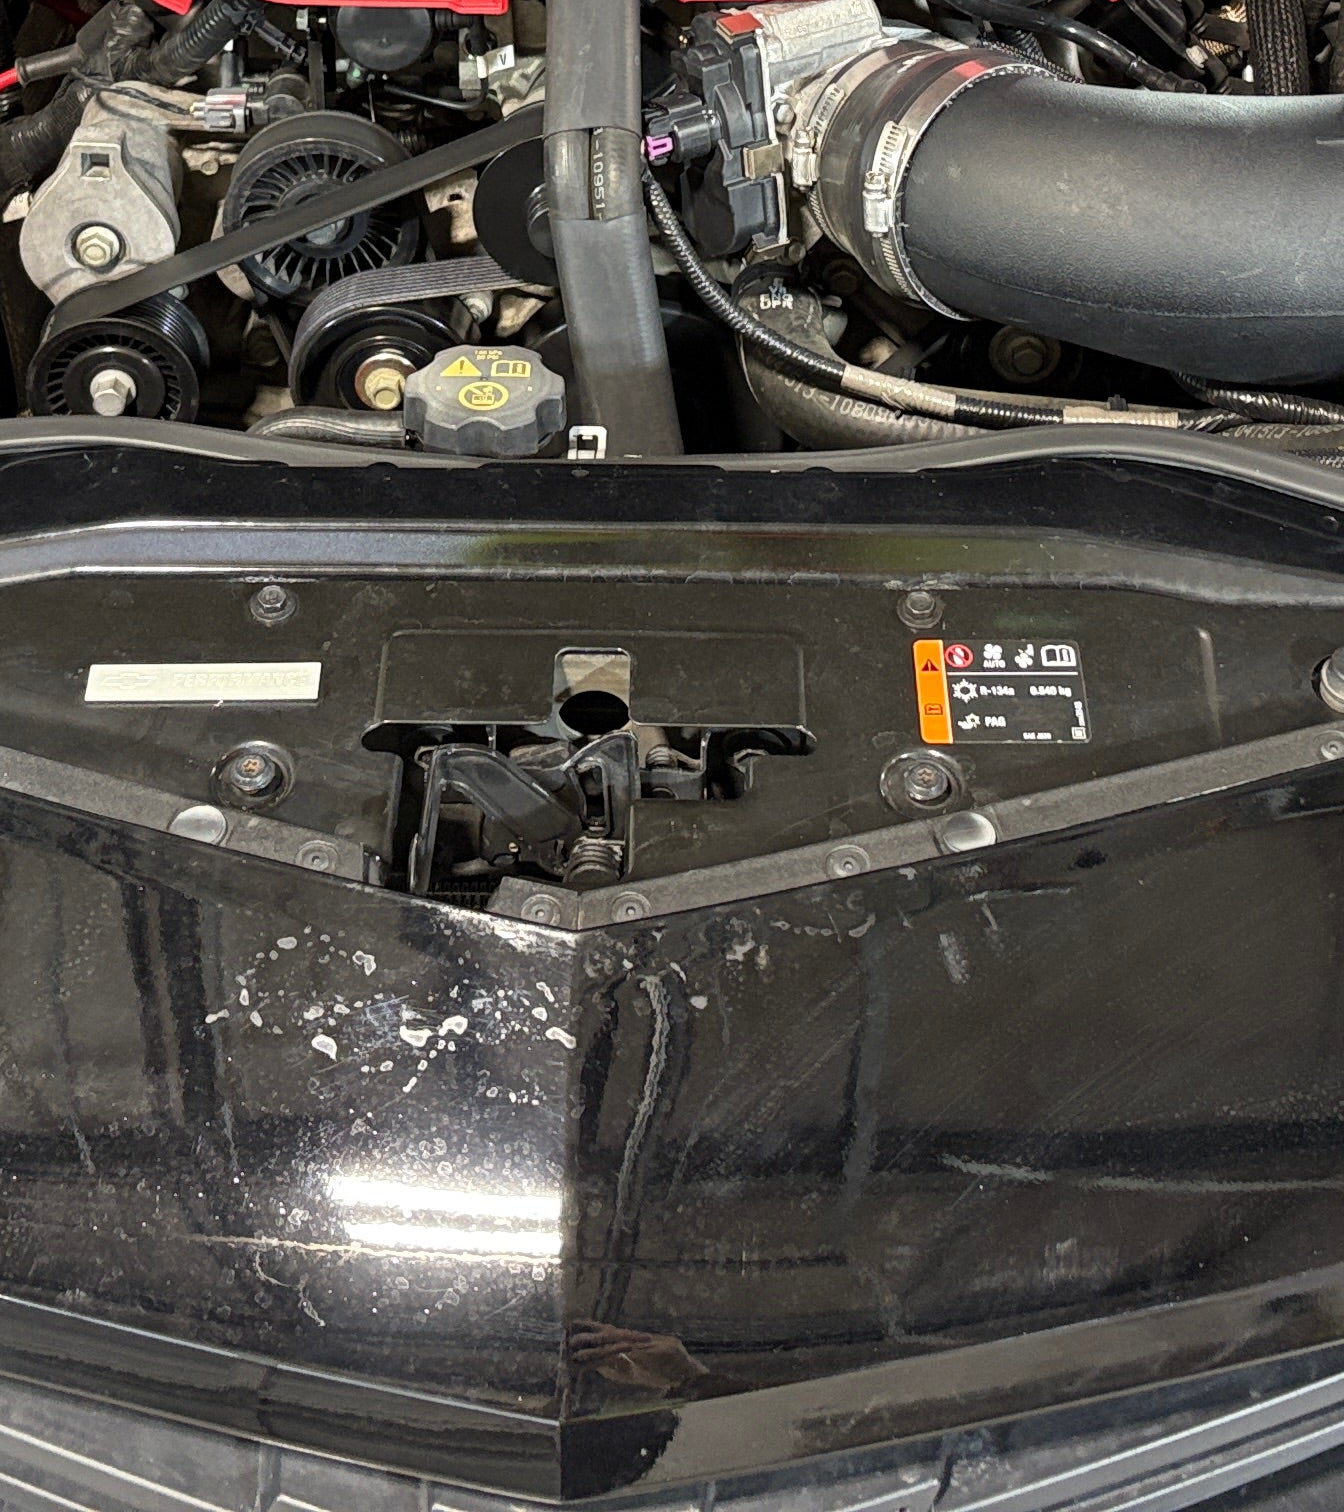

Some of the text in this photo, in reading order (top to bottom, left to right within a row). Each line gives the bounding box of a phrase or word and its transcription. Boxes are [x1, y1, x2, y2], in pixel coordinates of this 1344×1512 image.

[983, 659, 1006, 669] AUTO
[172, 671, 309, 688] PERFORMANCE
[979, 685, 1016, 696] R-134a
[984, 715, 1007, 728] PAG
